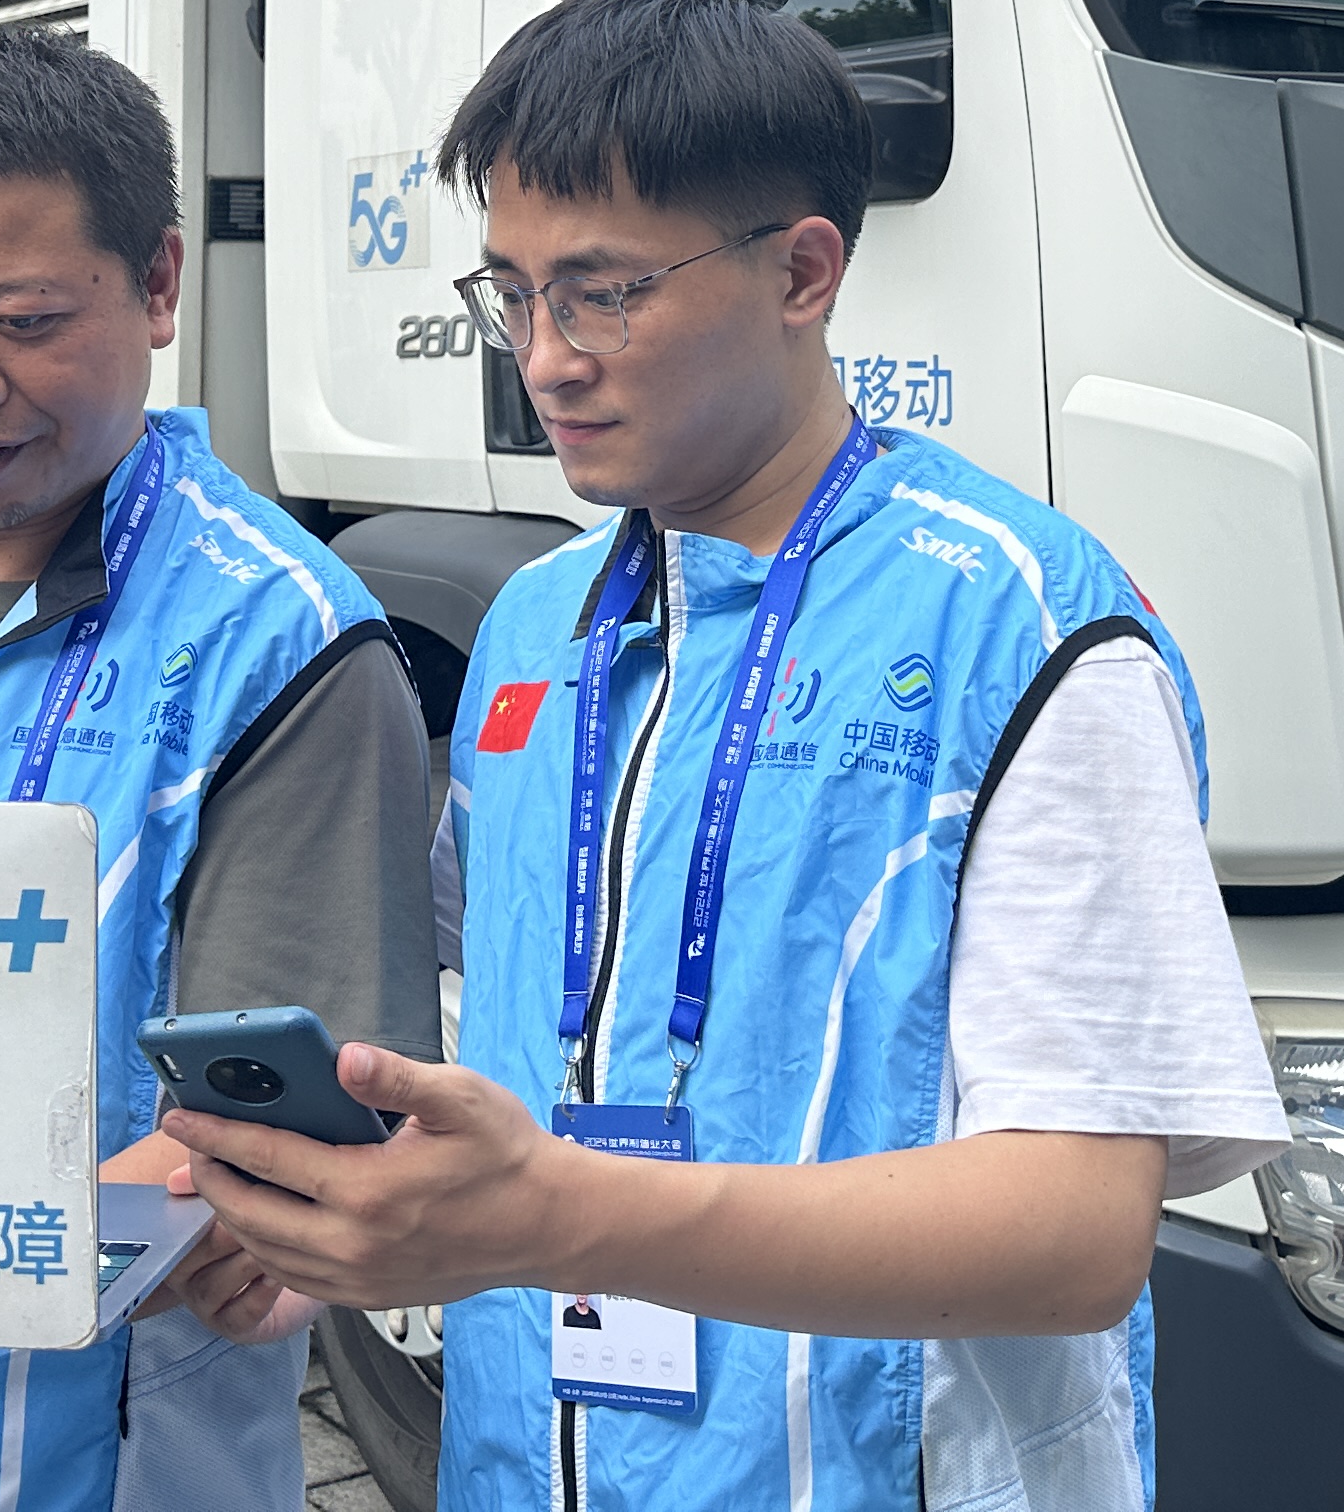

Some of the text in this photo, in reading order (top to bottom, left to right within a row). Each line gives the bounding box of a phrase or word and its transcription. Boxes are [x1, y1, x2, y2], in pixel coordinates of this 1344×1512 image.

[396, 313, 476, 359] 280
[832, 354, 953, 428] 移动
[898, 526, 987, 584] Santic
[843, 718, 941, 767] 中国移动
[840, 751, 935, 789] China Mobil
